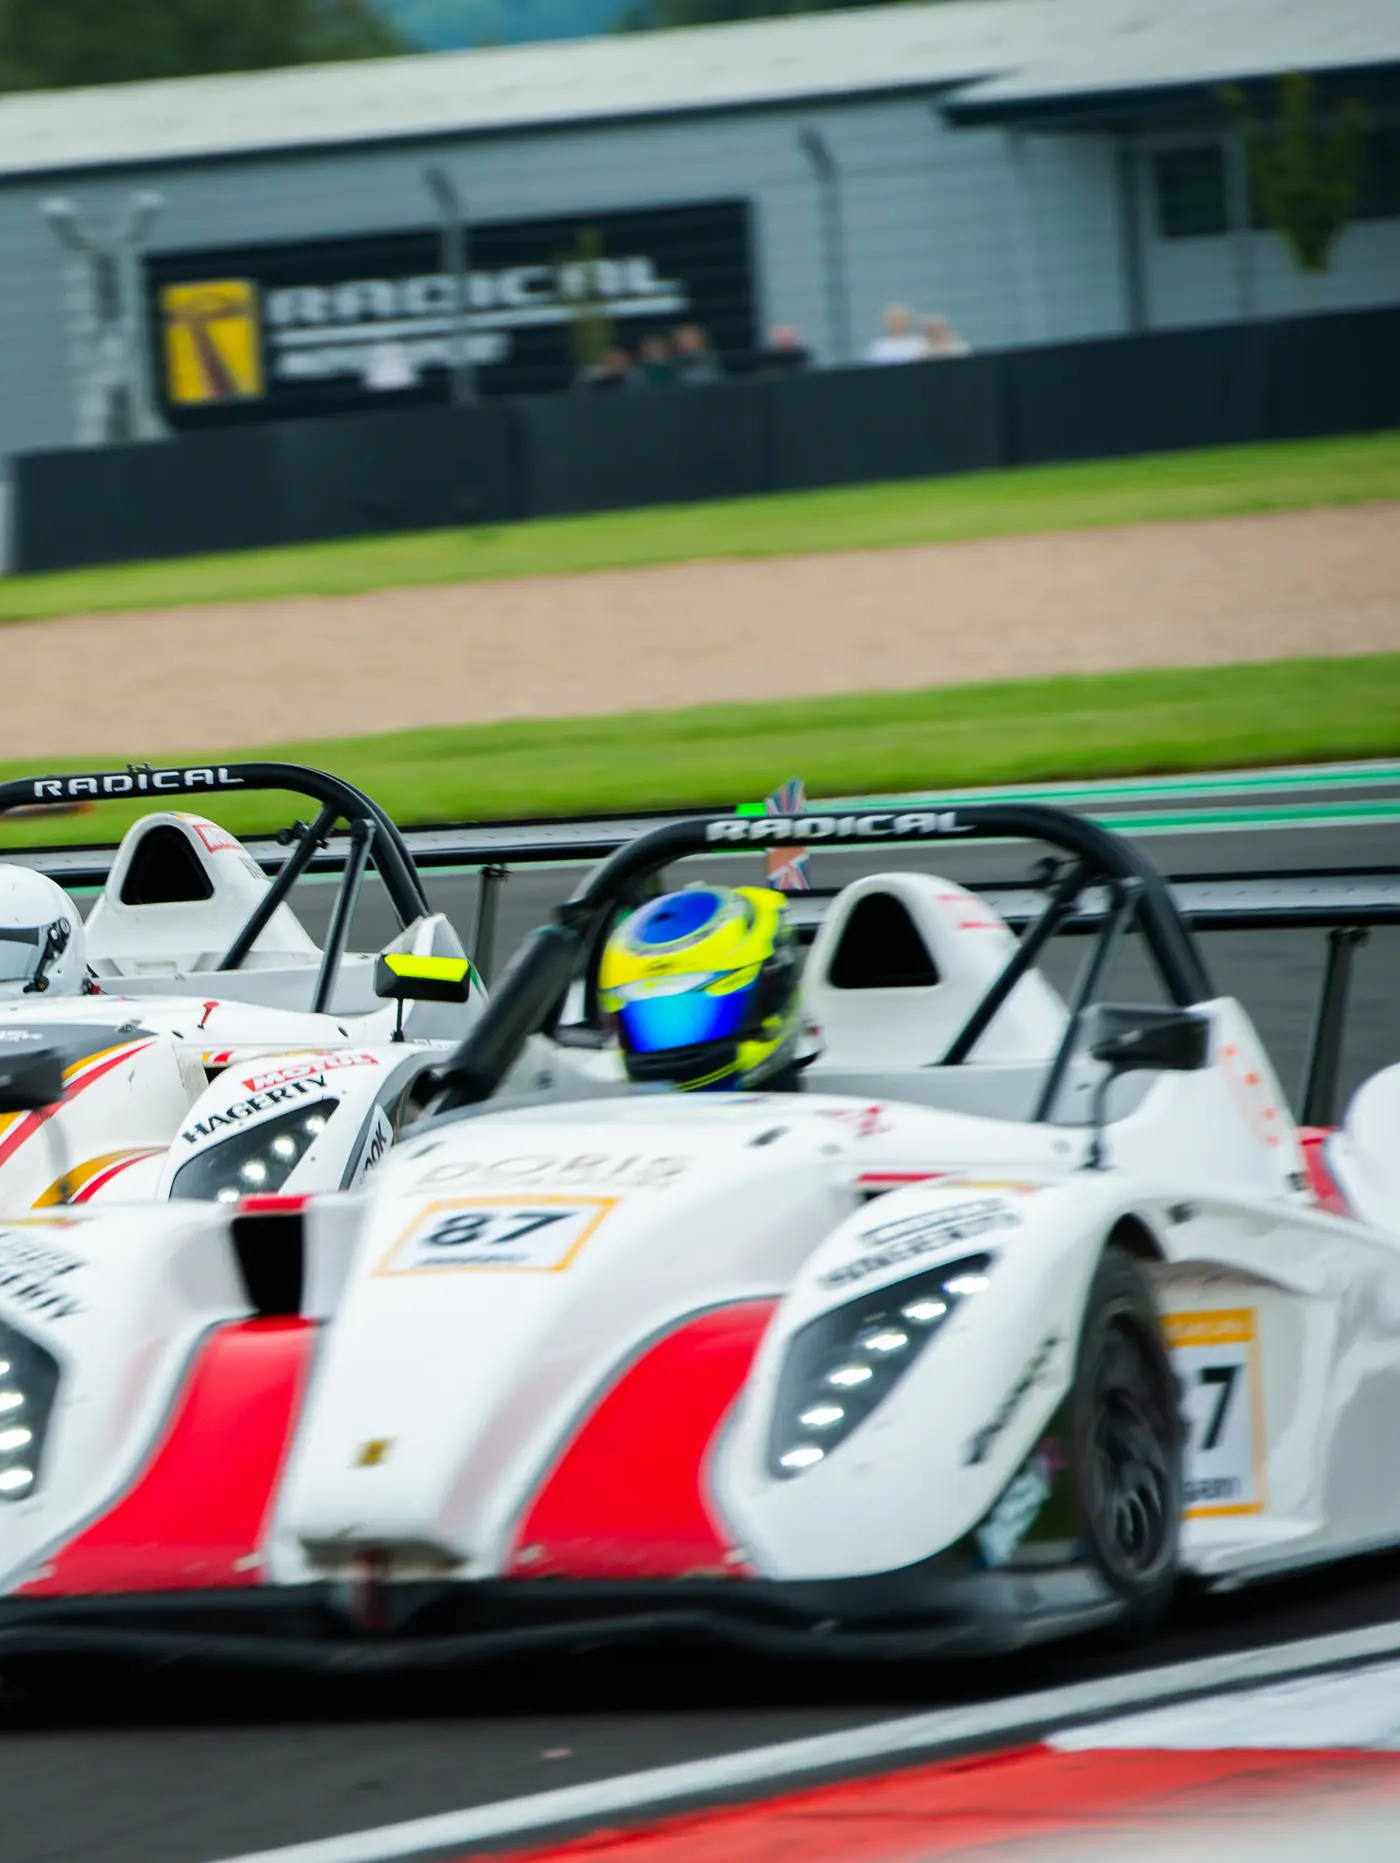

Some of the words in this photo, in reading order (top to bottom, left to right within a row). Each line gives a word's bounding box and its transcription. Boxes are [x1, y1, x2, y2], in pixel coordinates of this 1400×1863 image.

[34, 767, 244, 798] RADICAL
[706, 812, 976, 842] RADICAL
[252, 1054, 372, 1090] MOTUL
[182, 1073, 327, 1144] HAGERTY
[422, 1211, 576, 1246] 87
